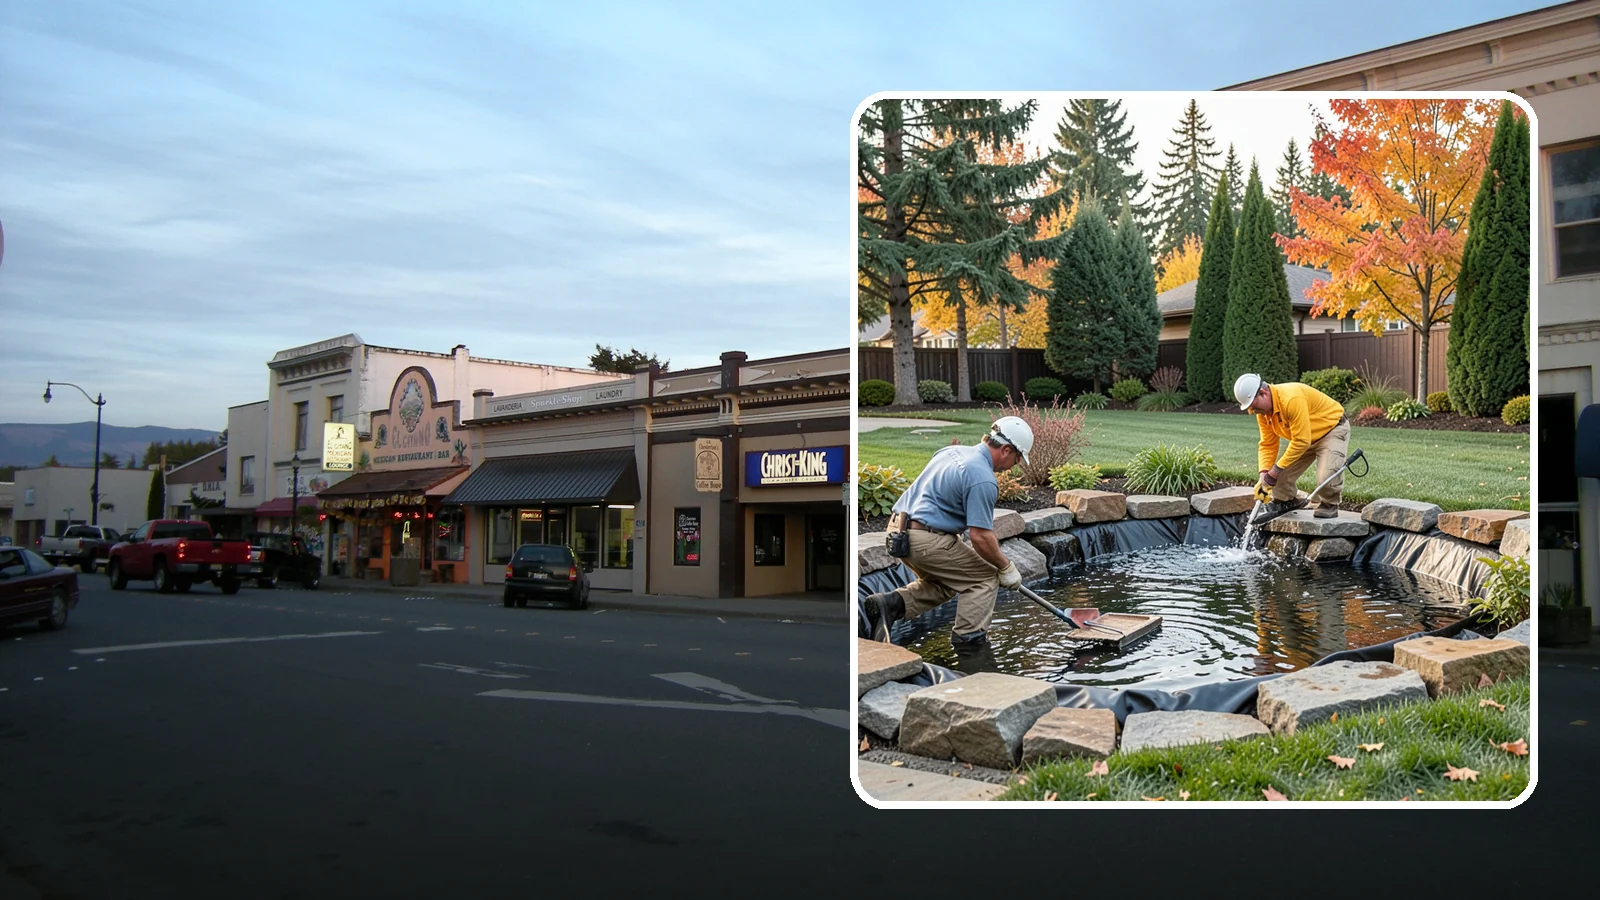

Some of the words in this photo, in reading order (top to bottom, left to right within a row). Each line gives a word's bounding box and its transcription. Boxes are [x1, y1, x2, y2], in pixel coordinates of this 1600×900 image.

[493, 402, 523, 413] LAVANDERIA
[530, 396, 561, 409] Sparkle
[562, 394, 583, 406] Shop
[595, 389, 624, 400] LAUNDRY
[373, 454, 396, 464] MEXICAN
[397, 451, 434, 462] RESTAURANT
[437, 450, 450, 459] BAR
[696, 481, 709, 489] Coffee
